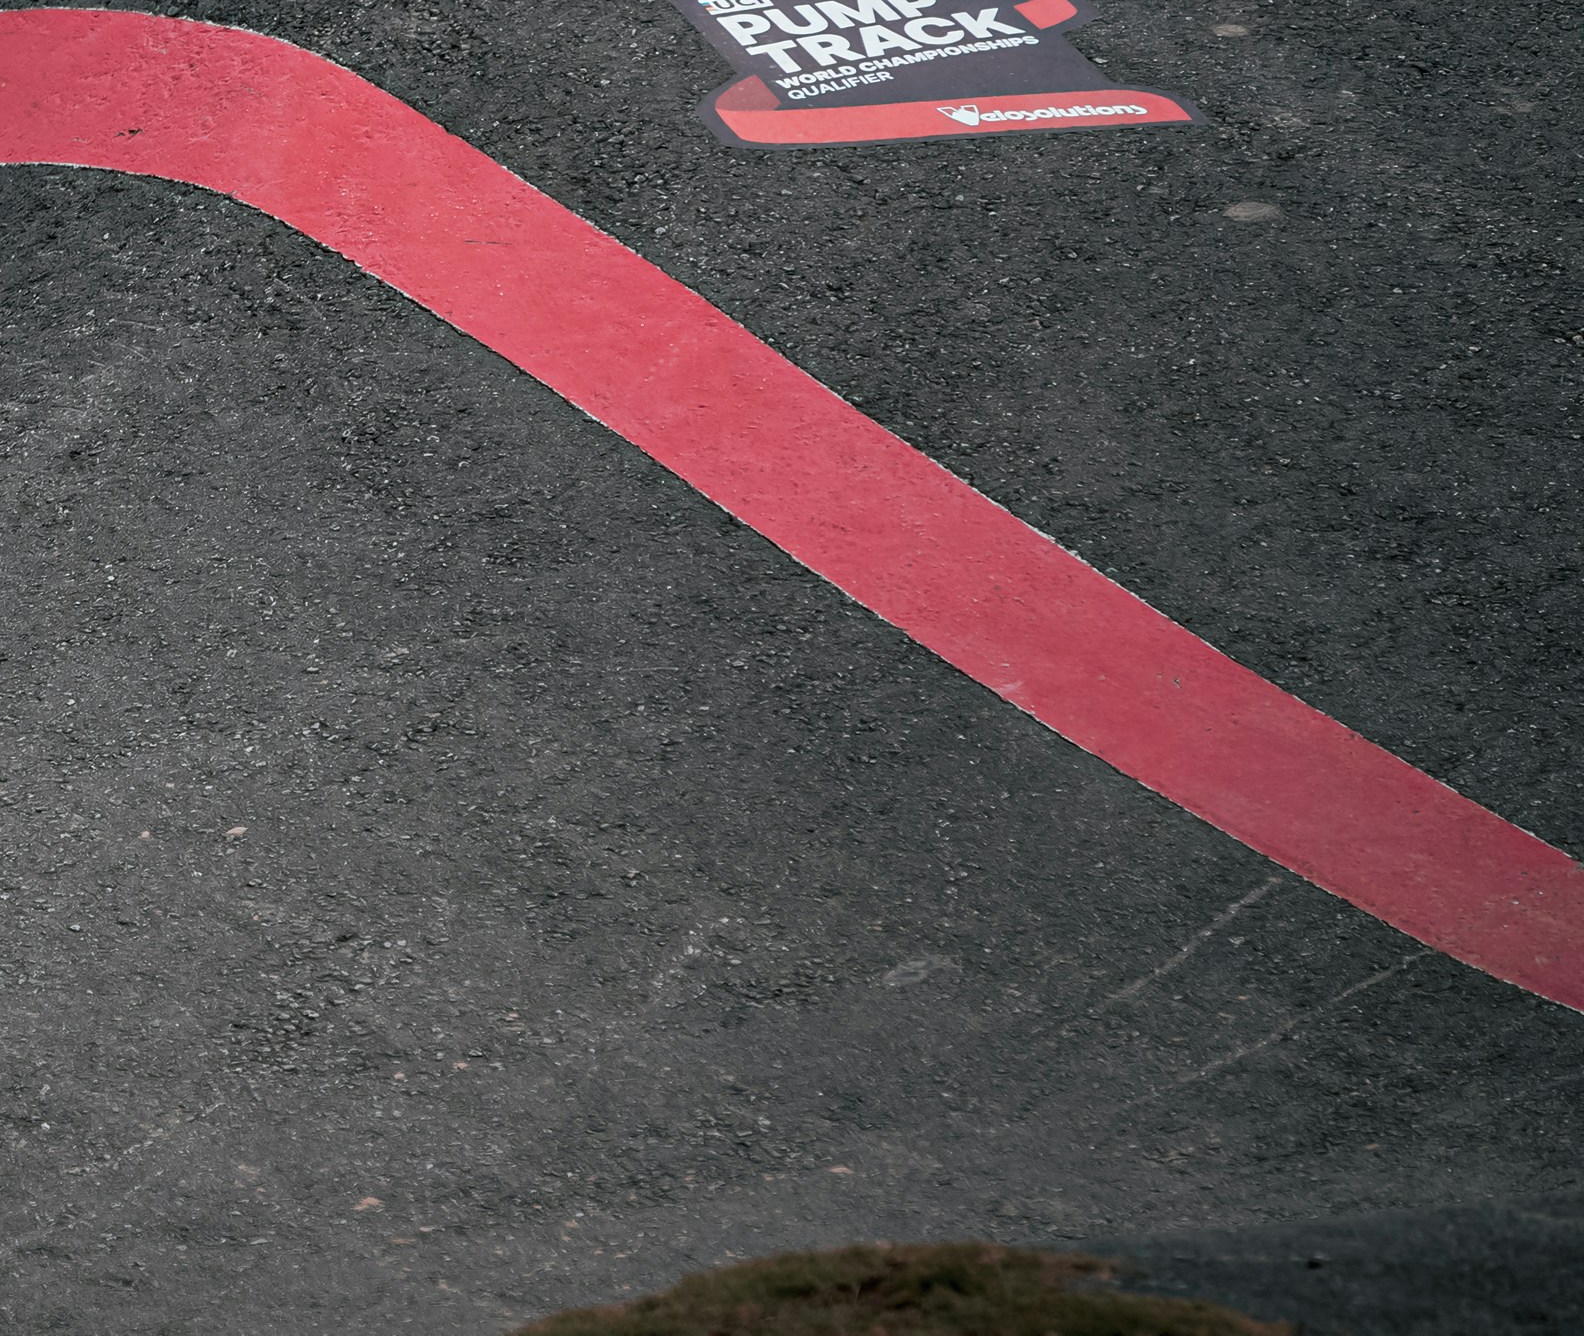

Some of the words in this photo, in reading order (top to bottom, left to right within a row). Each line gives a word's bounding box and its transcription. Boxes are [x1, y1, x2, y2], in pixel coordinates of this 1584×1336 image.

[745, 5, 1027, 75] TRACK
[775, 65, 858, 90] WORLD
[859, 35, 1040, 73] CHAMPIONSHIPS
[787, 70, 895, 100] QUALIFIER
